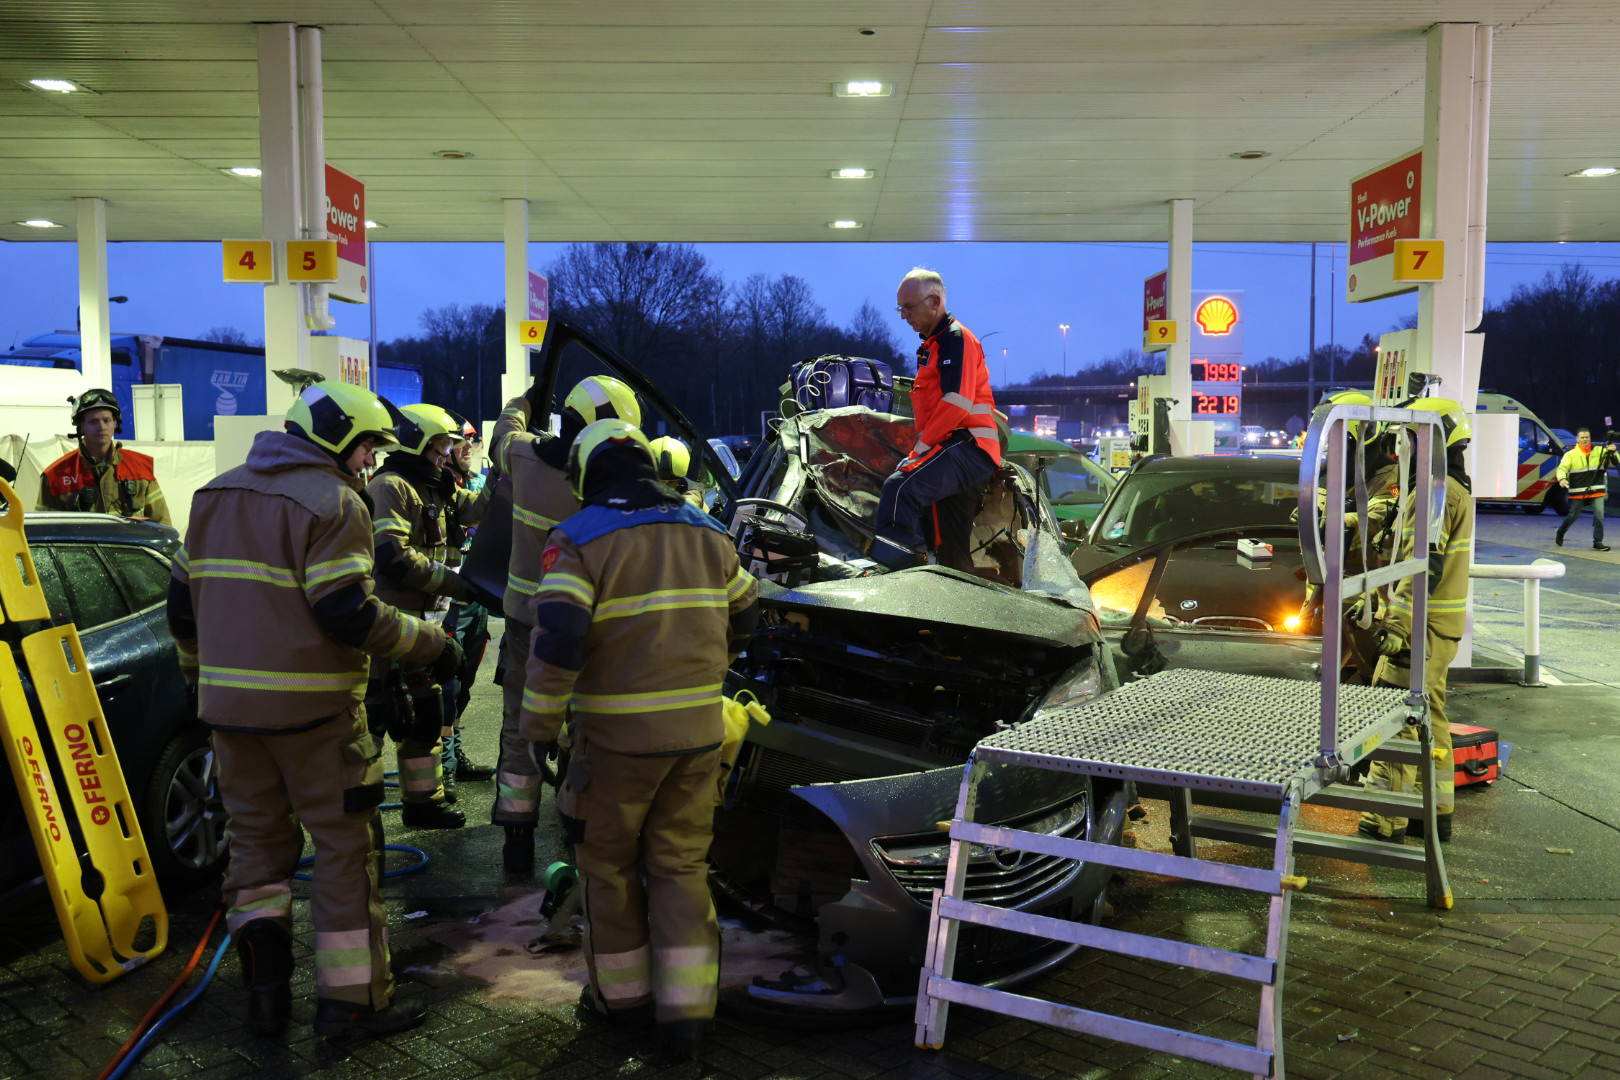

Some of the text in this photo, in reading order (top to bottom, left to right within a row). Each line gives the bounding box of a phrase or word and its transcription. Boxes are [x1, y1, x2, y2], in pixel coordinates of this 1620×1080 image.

[324, 195, 358, 232] Power
[1357, 196, 1412, 233] V-Power
[239, 250, 257, 271] 4
[302, 250, 317, 271] 5
[1413, 250, 1429, 270] 7
[528, 326, 538, 338] 6
[1159, 327, 1168, 338] 9
[64, 723, 107, 804] FERNO
[28, 759, 61, 841] FERNO
